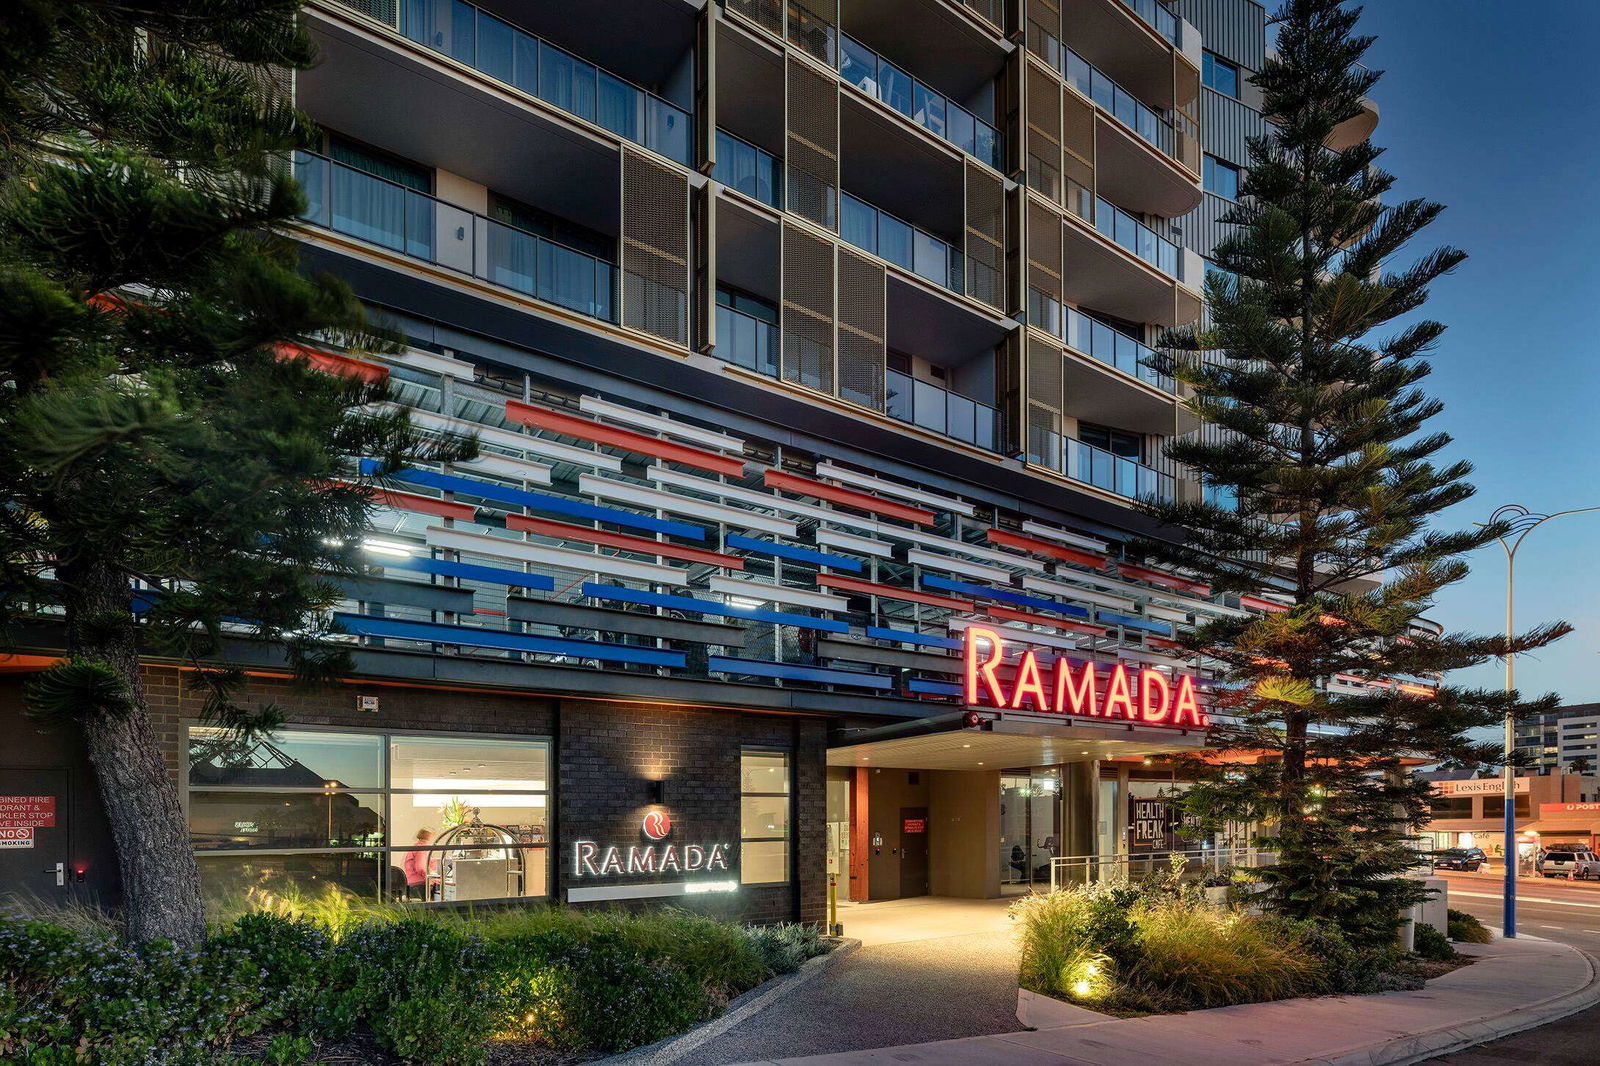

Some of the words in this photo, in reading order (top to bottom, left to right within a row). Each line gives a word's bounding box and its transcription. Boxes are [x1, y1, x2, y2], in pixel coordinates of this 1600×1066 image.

[1456, 783, 1482, 792] Lexis
[1483, 781, 1520, 793] Englh
[1136, 802, 1164, 819] HEALTH
[1136, 820, 1164, 839] FREAK
[576, 840, 729, 875] RAMADA
